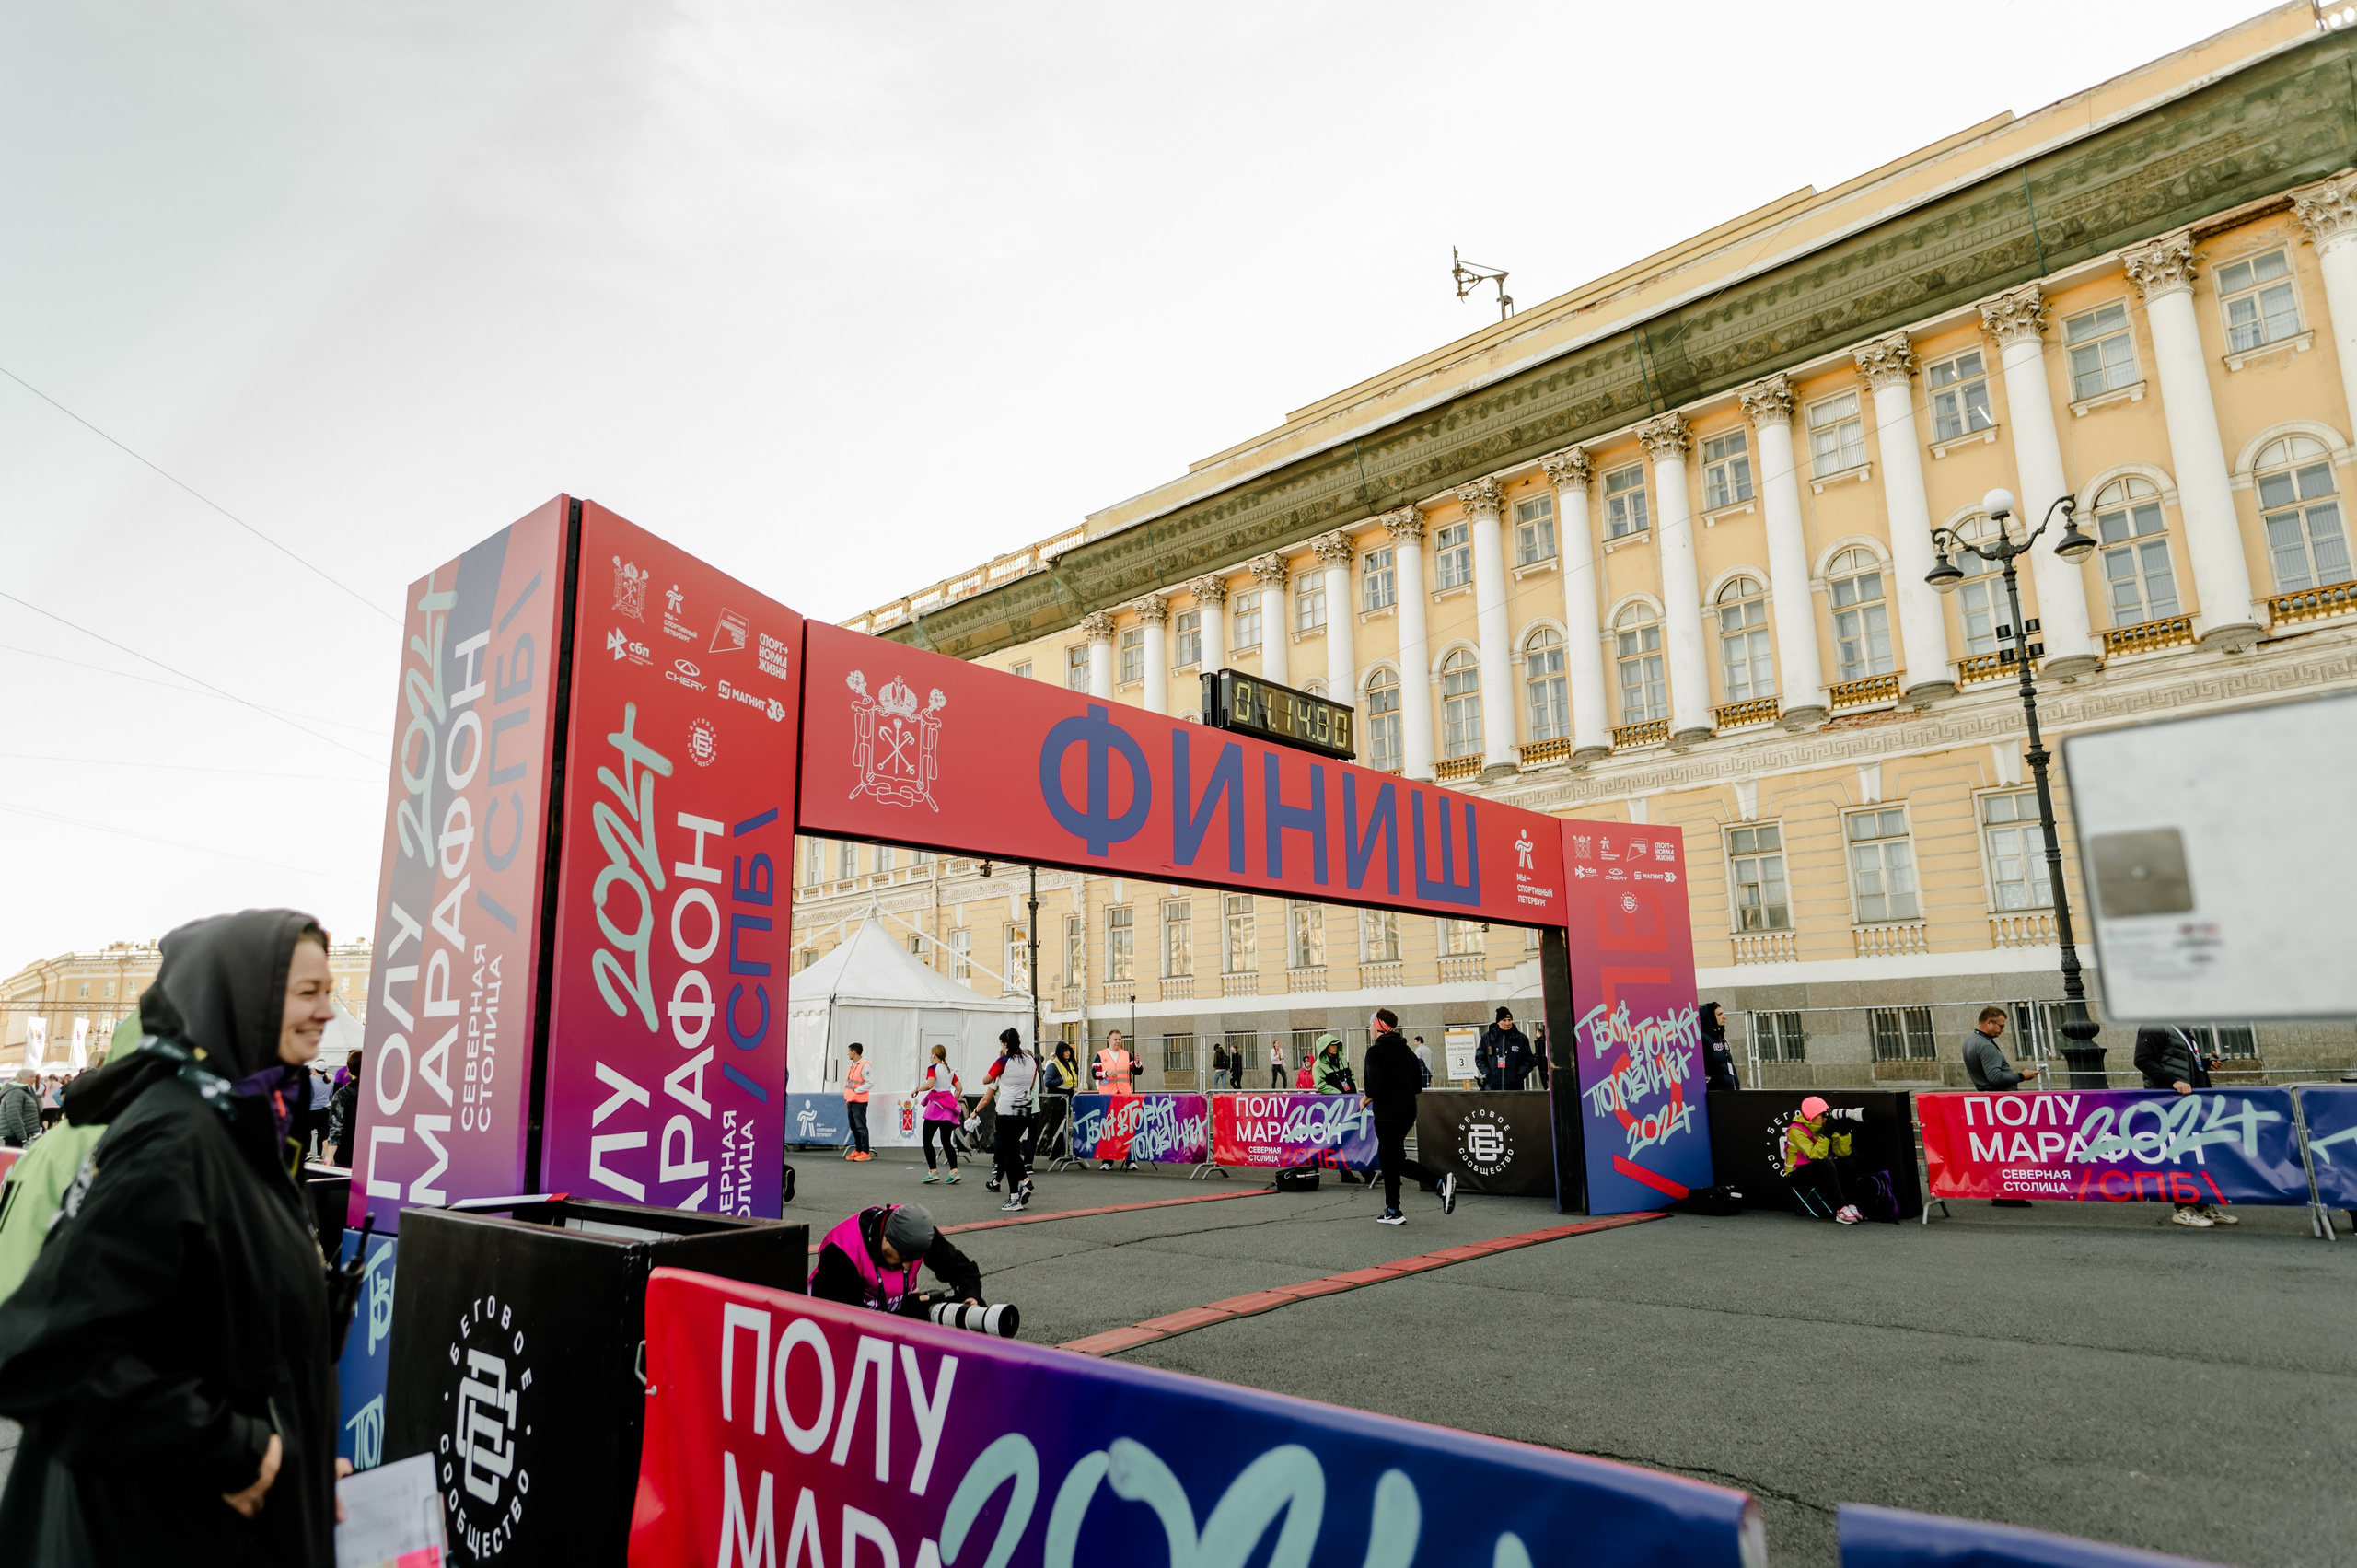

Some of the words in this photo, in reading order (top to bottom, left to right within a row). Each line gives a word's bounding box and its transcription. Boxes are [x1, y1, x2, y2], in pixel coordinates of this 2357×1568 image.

[665, 670, 707, 692] CHERY
[758, 645, 788, 669] НОРМА
[758, 657, 787, 681] ЖИЗНИ
[397, 569, 459, 868] 2024
[732, 689, 766, 711] МАГНИТ
[1039, 703, 1481, 908] ФИНИШ
[592, 702, 673, 1033] 2024
[1516, 883, 1553, 898] СПОРТИВНЫЙ
[409, 628, 490, 1207] МАРАФОН
[1517, 894, 1547, 907] ПЕТЕРБУРГ
[659, 811, 725, 1212] РАФОН
[366, 900, 424, 1201] ПОЛУ
[461, 943, 487, 1132] СЕВЕРНАЯ
[478, 954, 503, 1132] СТОЛИЦА
[1459, 1058, 1465, 1067] 3
[1236, 1096, 1290, 1118] ПОЛУ
[1285, 1098, 1375, 1144] 2024
[1458, 1109, 1511, 1132] БЕГОВОЕ
[1626, 1101, 1696, 1161] 2024
[1963, 1094, 2081, 1126] ПОЛУ
[2077, 1094, 2281, 1164] 2024
[1248, 1145, 1282, 1155] СЕВЕРНАЯ
[1248, 1155, 1279, 1163] СТОЛИЦА
[1458, 1147, 1515, 1177] СООБЩЕСТВО
[2002, 1168, 2072, 1180] СЕВЕРНАЯ
[2003, 1181, 2069, 1194] СТОЛИЦА
[449, 1295, 533, 1391] БЕГОВОЕ
[721, 1301, 959, 1497] ПОЛУ
[440, 1434, 529, 1560] СООБЩЕСТВО
